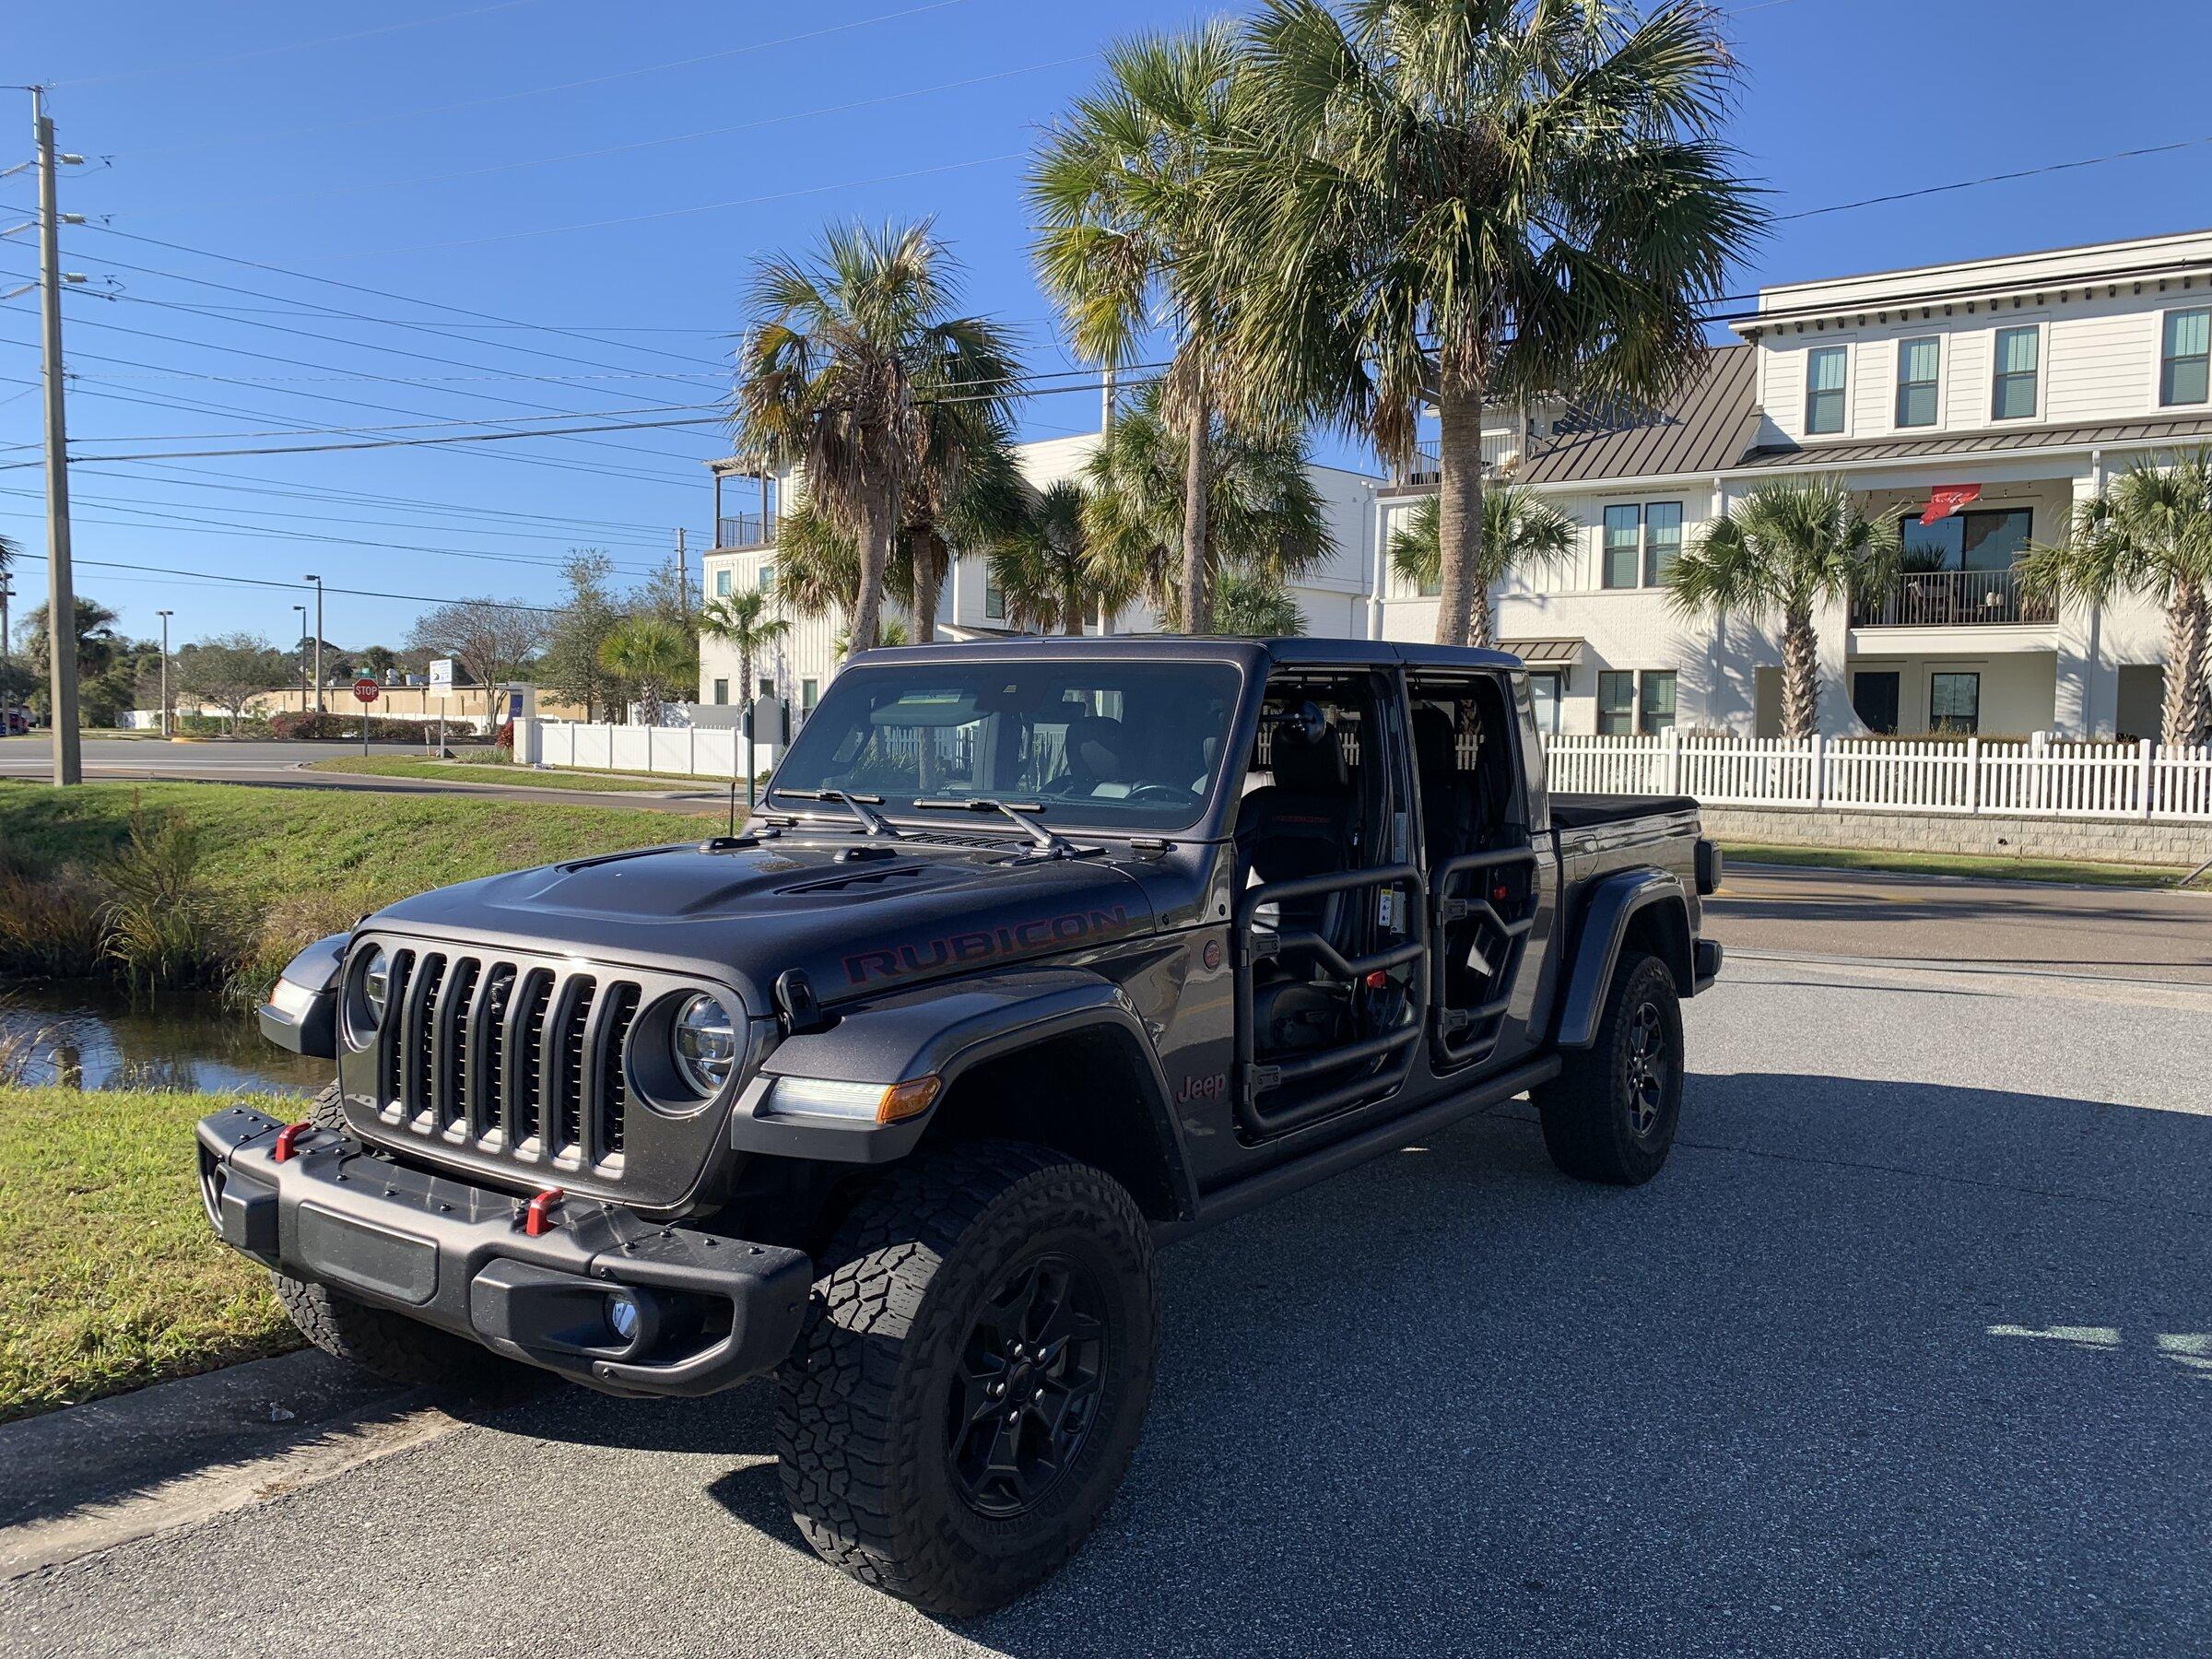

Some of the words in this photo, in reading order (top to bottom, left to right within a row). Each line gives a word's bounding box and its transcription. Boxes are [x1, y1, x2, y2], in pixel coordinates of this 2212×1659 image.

[356, 686, 377, 696] STOP
[842, 906, 1128, 984] RUBICON
[1175, 1073, 1225, 1102] Jeep
